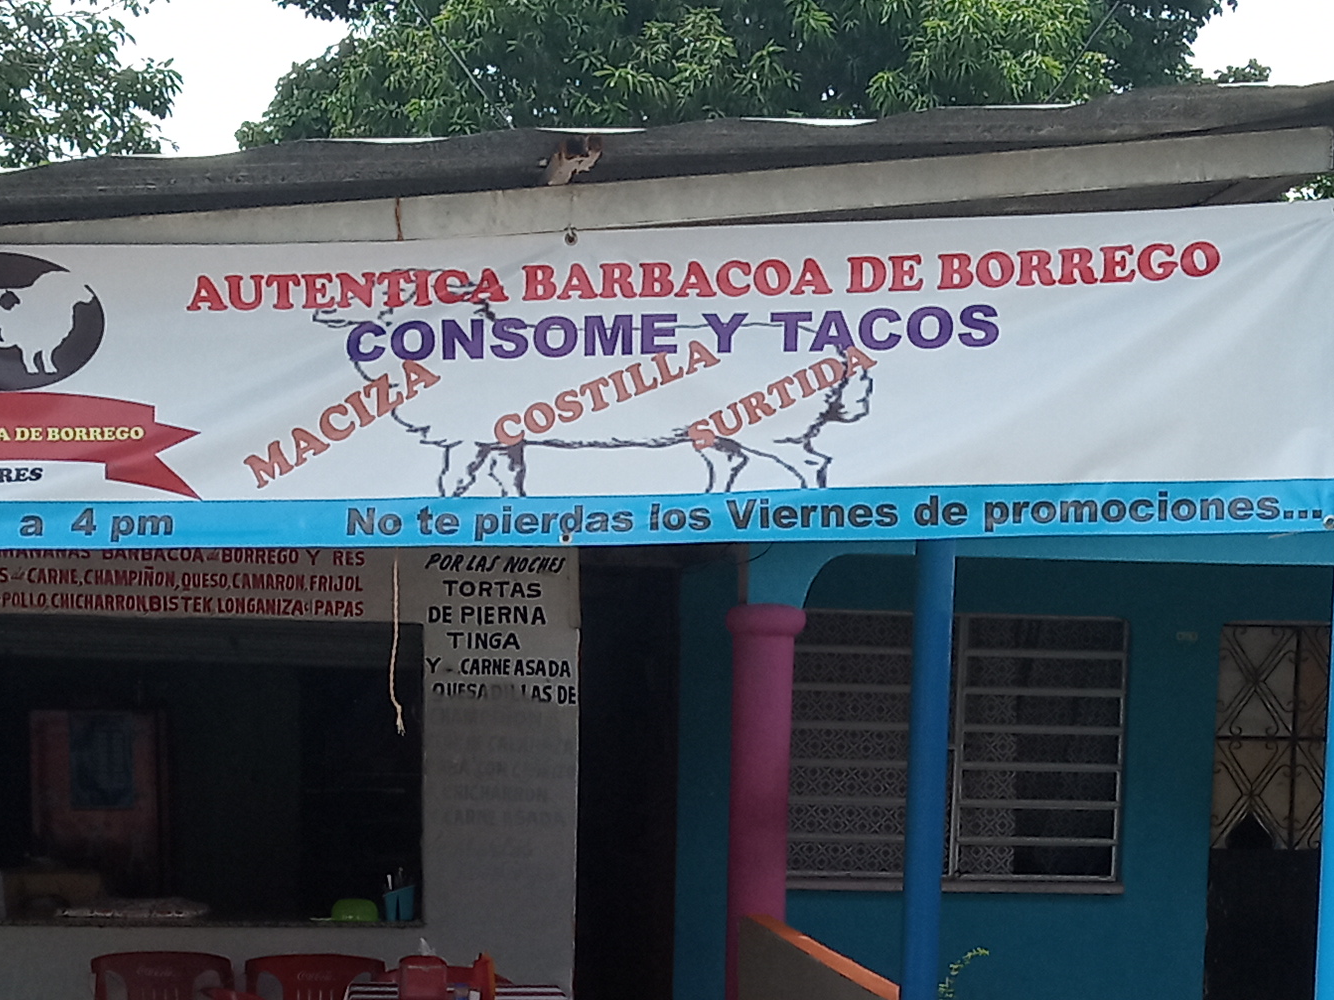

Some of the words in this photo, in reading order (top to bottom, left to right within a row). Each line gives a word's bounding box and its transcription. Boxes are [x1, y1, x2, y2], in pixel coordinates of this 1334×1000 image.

[186, 265, 510, 314] AUTENTICA
[521, 257, 834, 302] BARBACOA
[846, 253, 924, 295] DE
[936, 240, 1222, 291] BORREGO
[346, 312, 679, 362] CONSOME
[703, 312, 749, 355] Y
[770, 303, 1001, 353] TACOS
[493, 339, 721, 448] COSTILLA
[687, 345, 878, 450] SURTIDA
[14, 426, 42, 443] DE
[45, 424, 145, 443] BORREGO
[243, 359, 441, 490] MACIZA
[18, 513, 44, 538] a
[70, 507, 98, 537] 4
[109, 512, 174, 543] pm
[345, 506, 403, 537] No
[416, 505, 460, 537] te
[473, 504, 634, 542] pierdas
[649, 502, 712, 532] los
[725, 494, 901, 532] Viernes
[913, 495, 969, 528] de
[983, 490, 1325, 533] promociones...
[102, 548, 204, 563] BARBACOA
[221, 548, 299, 564] BORREGO
[306, 549, 321, 566] Y
[333, 550, 365, 566] RES
[425, 552, 465, 573] POR
[467, 554, 501, 573] LAS
[503, 555, 566, 574] NOCHES
[309, 574, 364, 592] FRIJOL
[442, 579, 543, 599] TORTAS
[217, 597, 304, 616] LONGANIZA
[314, 599, 364, 617] PAPAS
[428, 605, 453, 624] DE
[460, 605, 547, 626] PIERNA
[446, 631, 521, 650] TINGA
[425, 656, 442, 674] Y
[460, 658, 511, 676] CARNE
[514, 659, 571, 678] ASADA
[557, 685, 577, 705] DE
